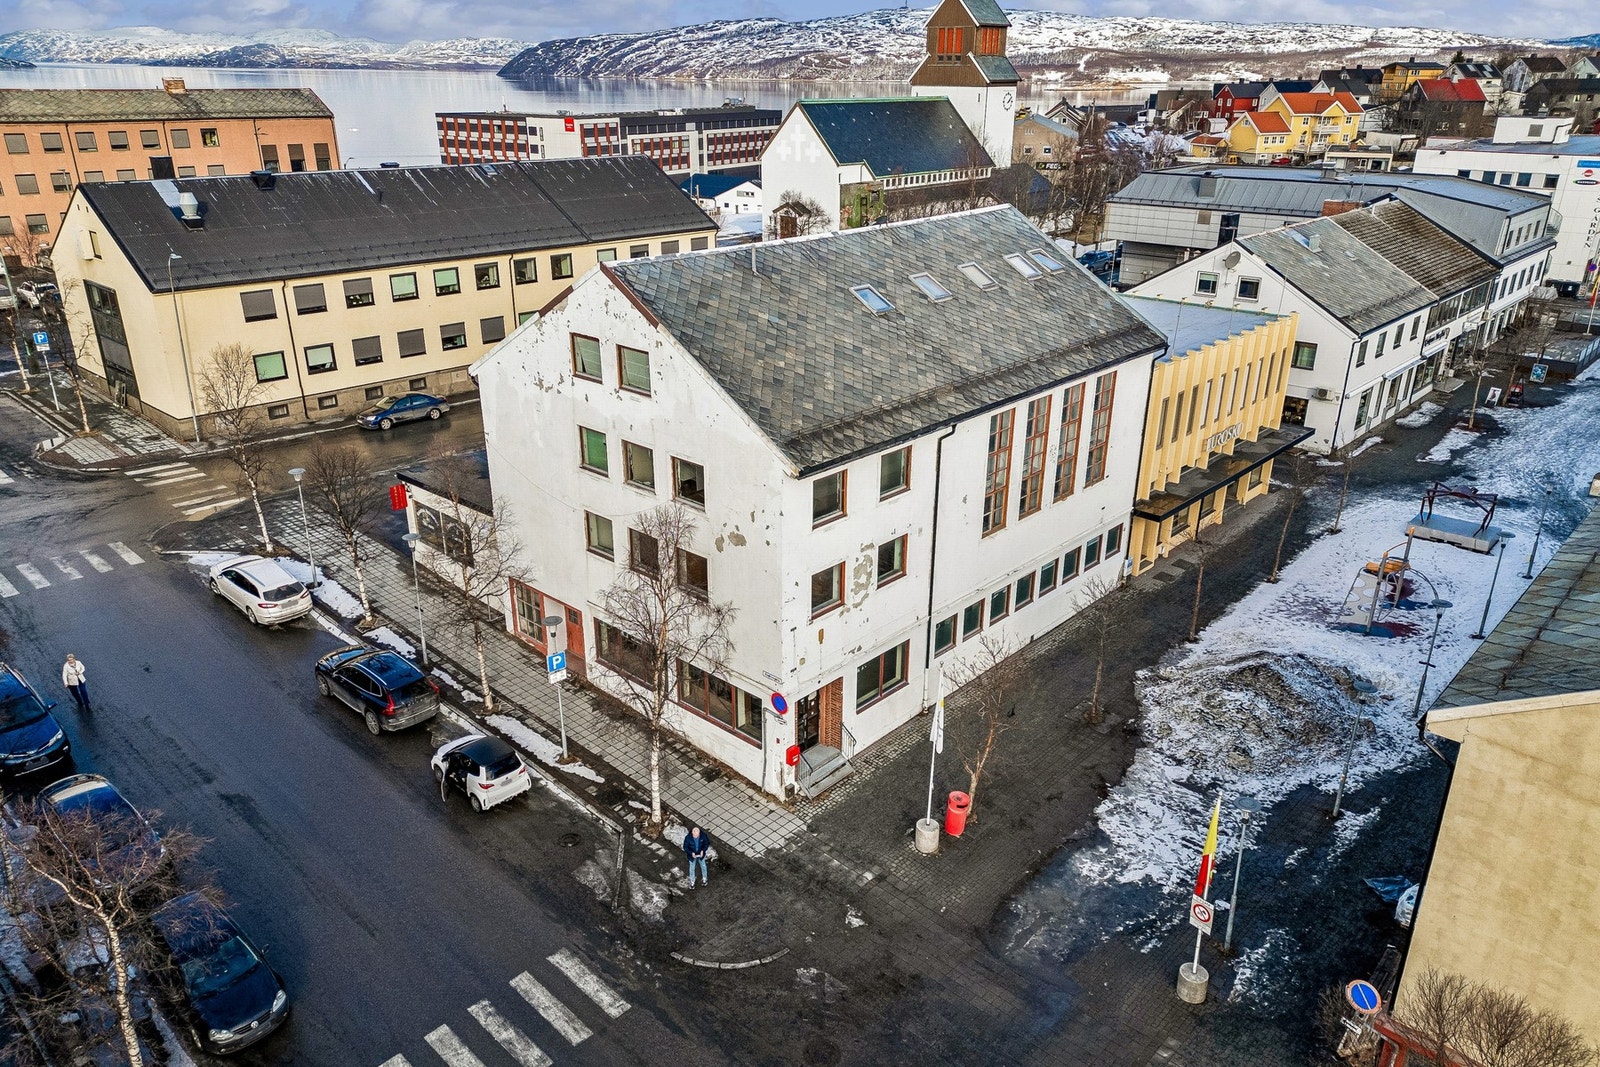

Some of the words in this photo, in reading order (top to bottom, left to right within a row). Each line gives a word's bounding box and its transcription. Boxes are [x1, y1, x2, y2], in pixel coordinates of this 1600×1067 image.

[1584, 207, 1600, 248] GARDEN
[37, 334, 45, 343] P
[552, 656, 562, 670] P
